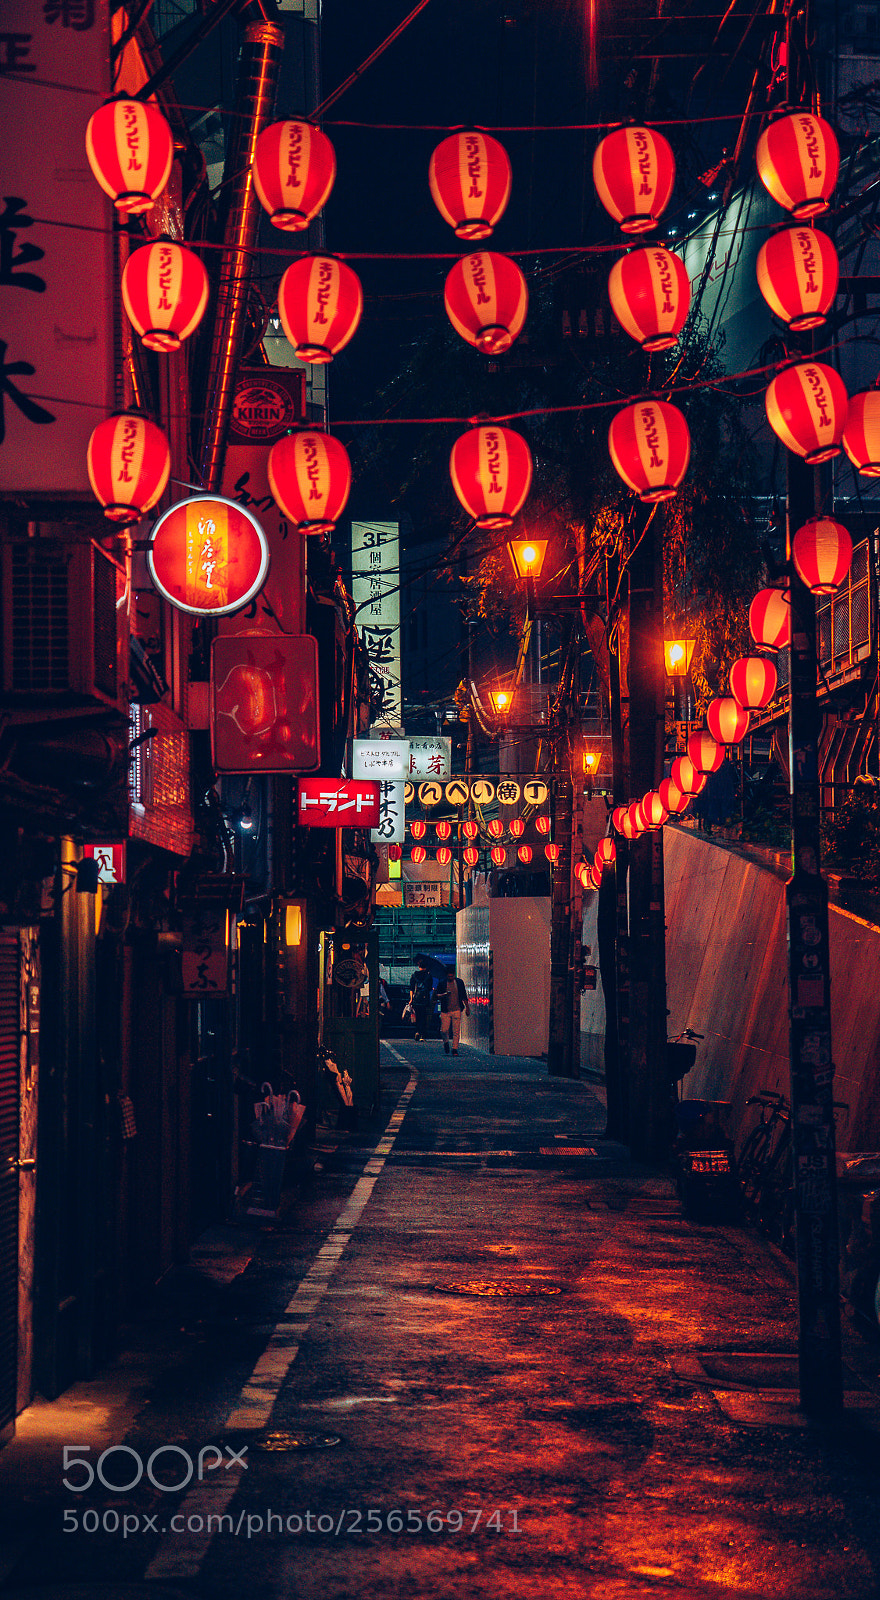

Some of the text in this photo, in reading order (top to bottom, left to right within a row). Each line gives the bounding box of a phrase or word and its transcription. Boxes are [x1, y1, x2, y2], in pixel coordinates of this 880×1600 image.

[122, 105, 142, 171] キリンビール
[286, 124, 304, 188] キリンビール
[464, 135, 483, 199] キリンビール
[632, 131, 653, 197] キリンビール
[799, 117, 822, 179] キリンビール
[157, 247, 173, 311] キリンビール
[313, 261, 333, 325] キリンビール
[653, 251, 675, 315] キリンビール
[800, 231, 819, 294] キリンビール
[238, 407, 280, 420] KIRIN
[804, 367, 833, 428] キリンビール
[118, 420, 137, 484] キリンビール
[485, 431, 503, 494] キリンビール
[640, 407, 664, 468] キリンビール
[302, 438, 323, 501] キリンビール
[363, 532, 387, 547] 3F
